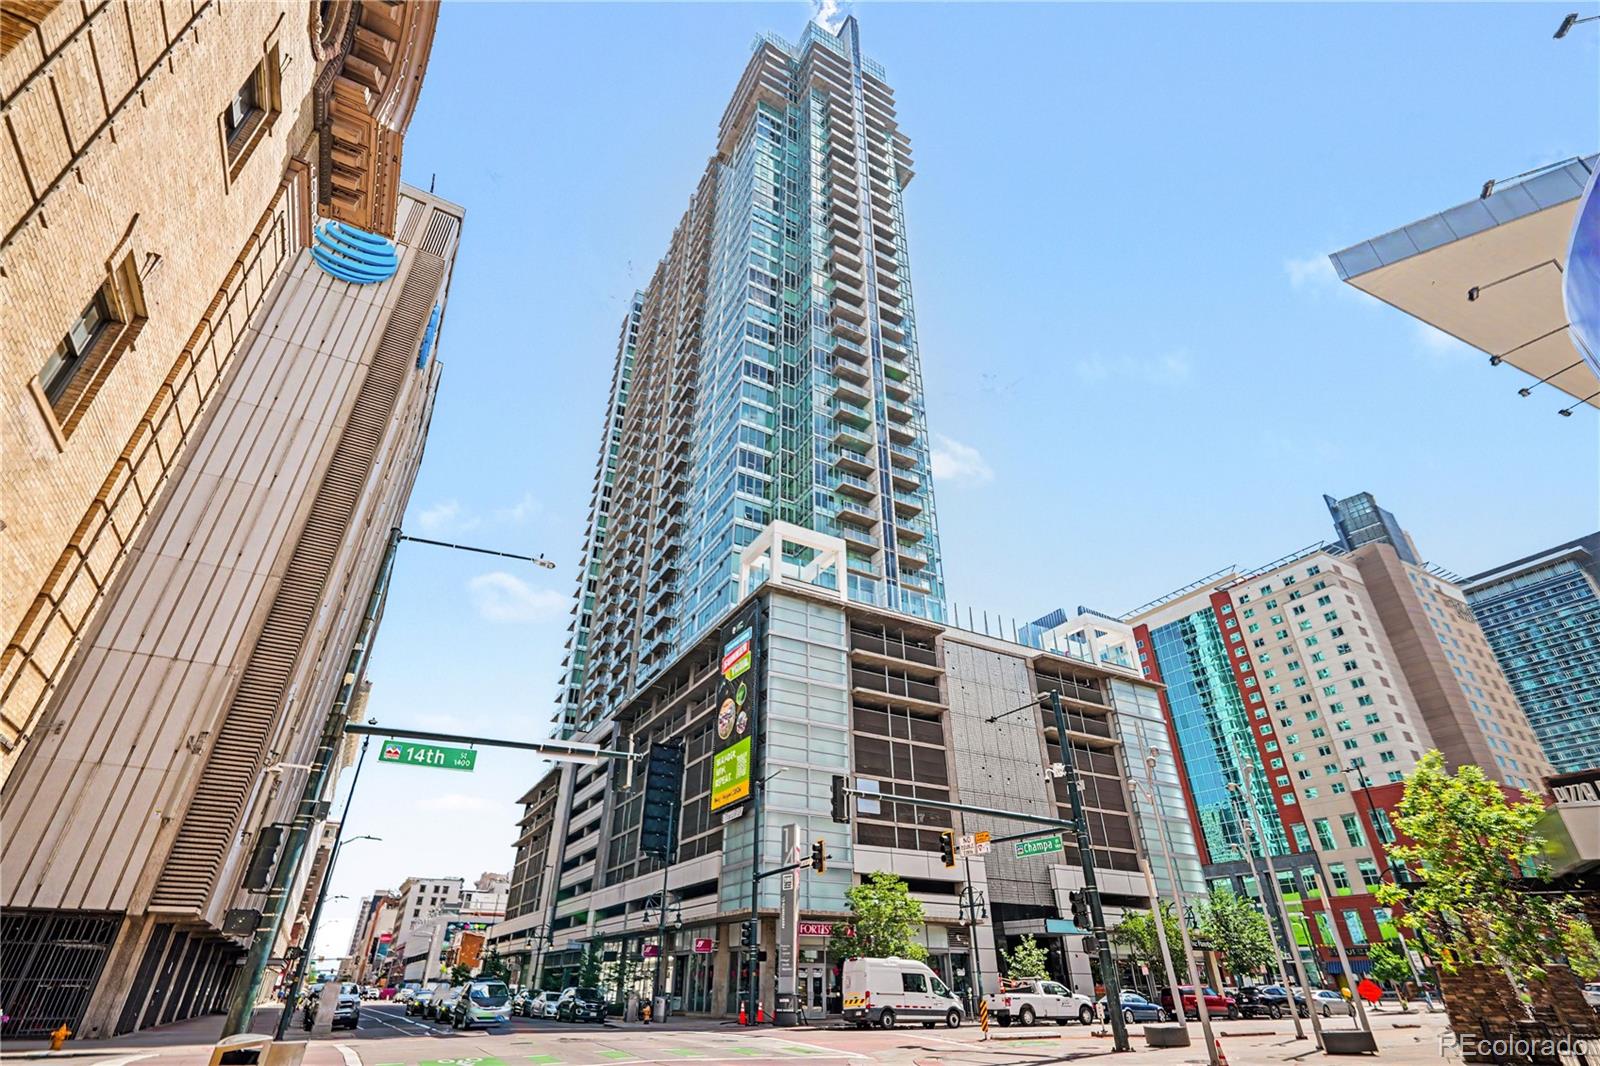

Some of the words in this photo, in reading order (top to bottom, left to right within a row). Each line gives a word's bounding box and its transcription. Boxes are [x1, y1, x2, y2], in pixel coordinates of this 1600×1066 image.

[406, 747, 446, 765] 14th
[1552, 782, 1598, 804] PIZZA
[1023, 840, 1053, 853] Champa
